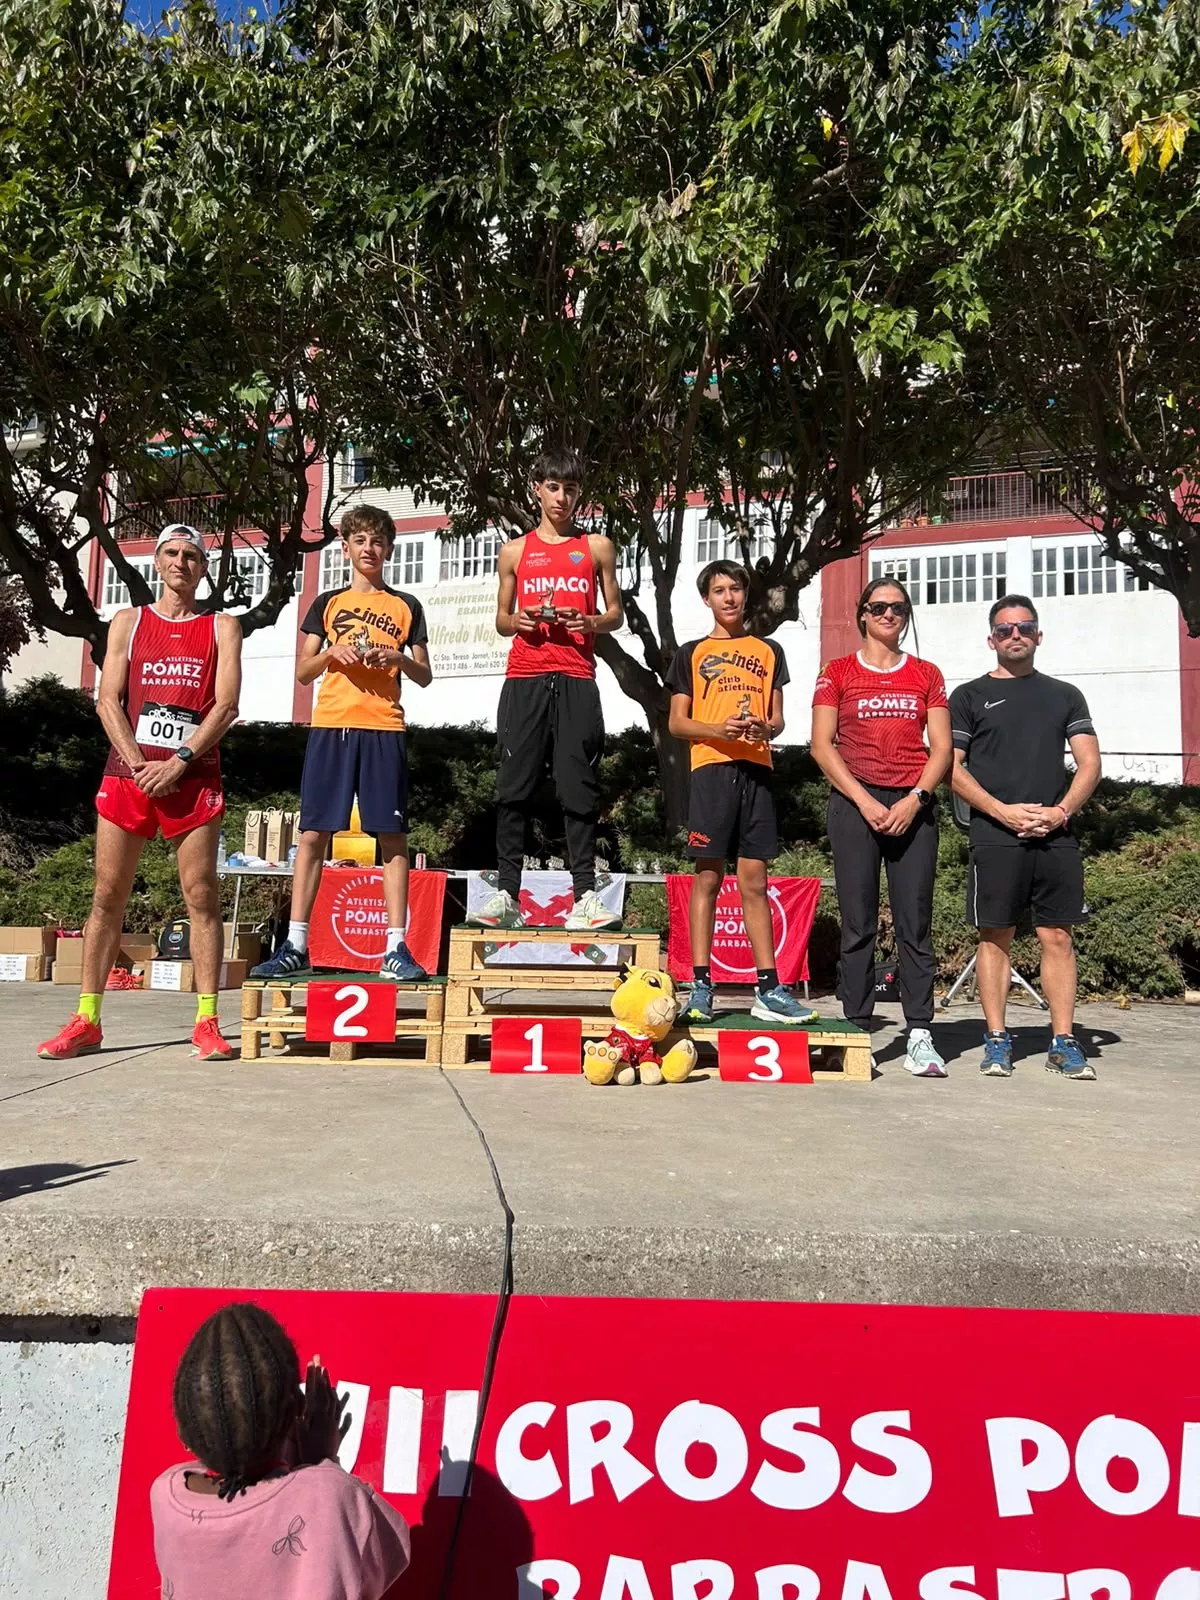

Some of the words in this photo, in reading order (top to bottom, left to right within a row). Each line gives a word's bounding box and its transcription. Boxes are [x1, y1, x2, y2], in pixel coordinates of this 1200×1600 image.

[523, 576, 589, 595] HINACO
[428, 593, 496, 606] CARPINTERIA
[457, 605, 498, 616] EBANIS
[166, 656, 204, 664] ATLETISMO
[142, 659, 202, 678] PÓMEZ
[141, 678, 200, 688] BARBASTRO
[718, 675, 741, 684] club
[717, 683, 763, 694] atletismo
[857, 696, 918, 711] PÓMEZ
[150, 721, 185, 741] 001
[346, 898, 387, 907] ATLETIS
[345, 907, 388, 925] PÓME
[344, 927, 389, 936] BARBAST
[333, 984, 369, 1037] 2
[523, 1023, 549, 1072] 1
[747, 1036, 783, 1081] 3
[495, 1400, 933, 1513] CROSS
